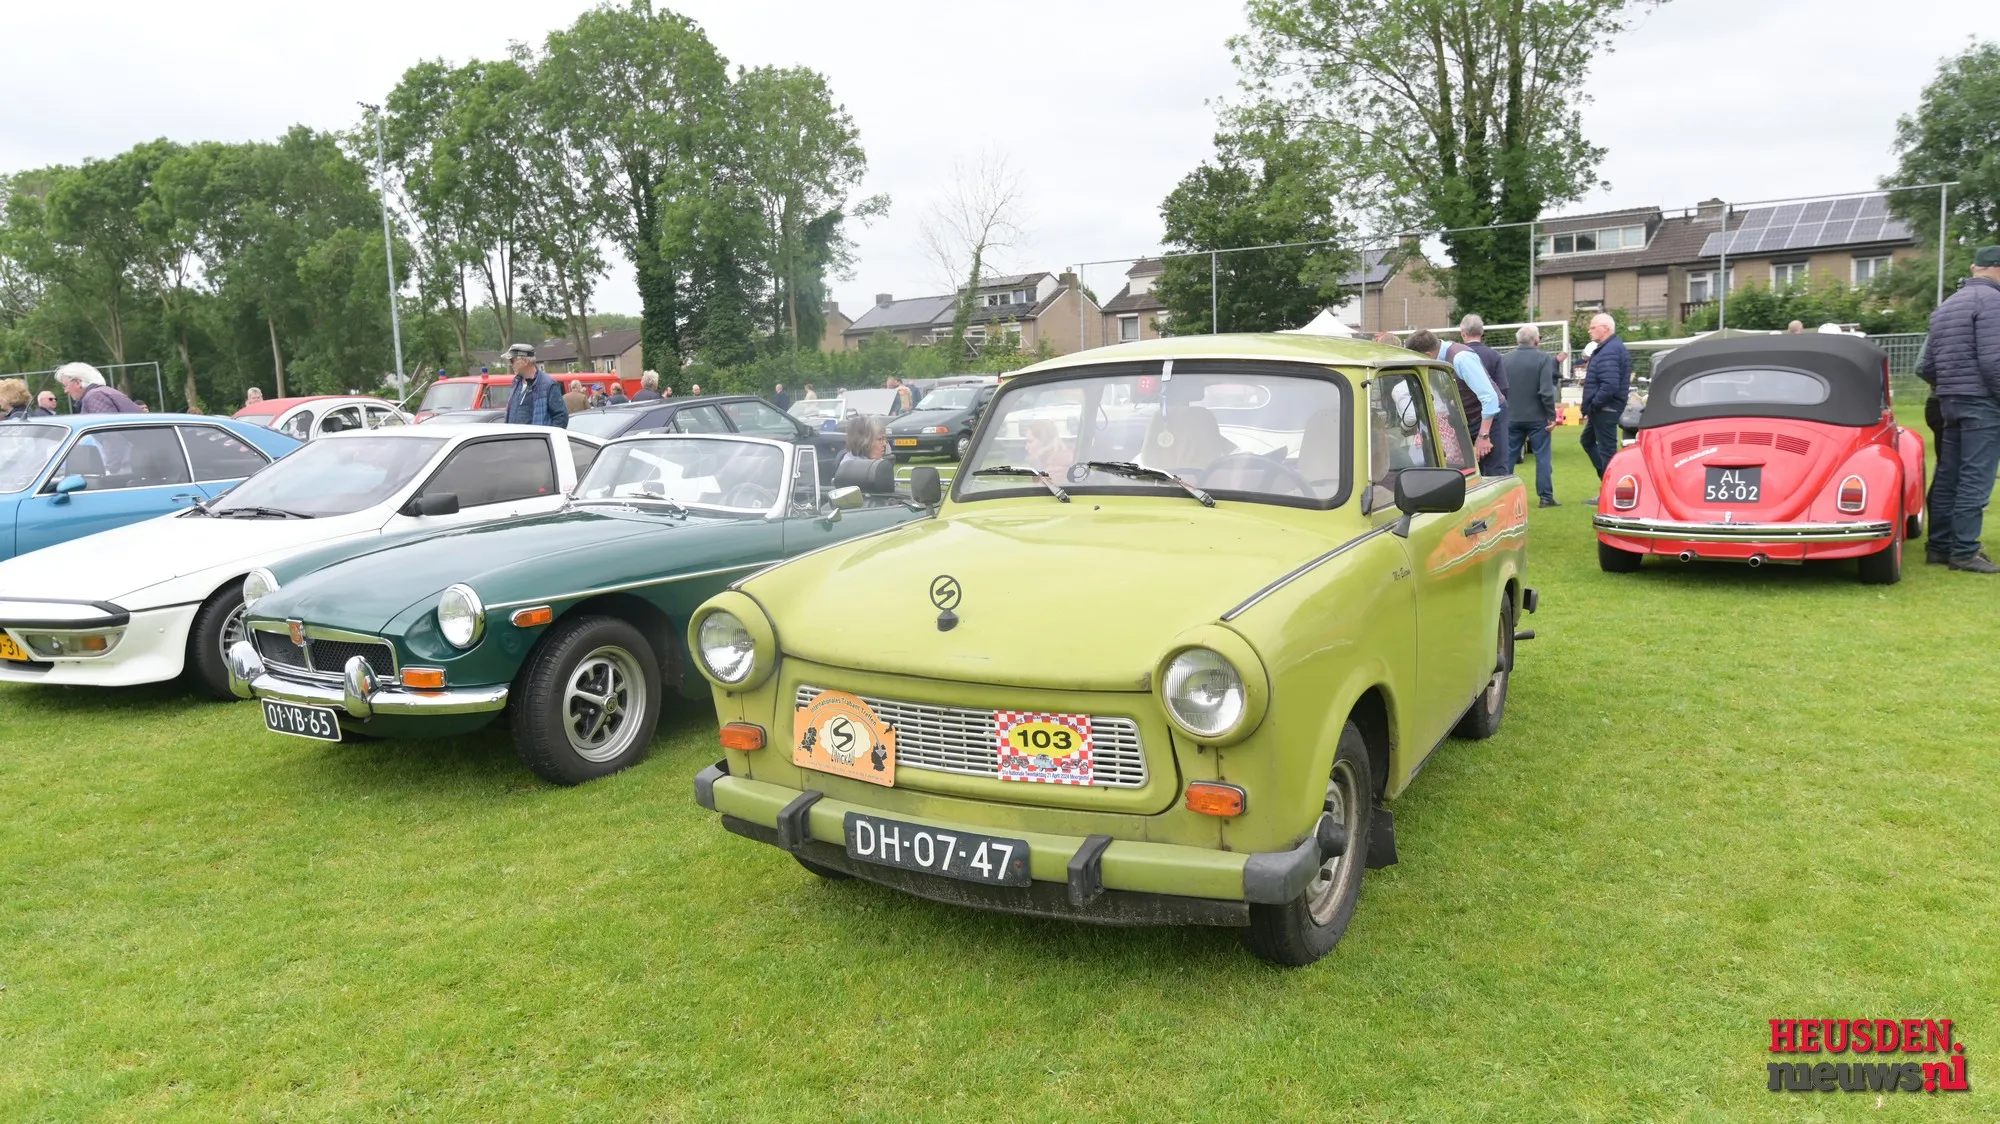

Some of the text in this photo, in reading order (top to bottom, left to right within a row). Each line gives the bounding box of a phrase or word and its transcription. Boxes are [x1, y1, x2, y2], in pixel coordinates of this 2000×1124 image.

[1720, 470, 1746, 484] AL
[1706, 485, 1758, 500] 56-02
[0, 638, 20, 657] -31
[268, 704, 331, 736] 01-YB-65
[1017, 730, 1072, 750] 103
[856, 820, 1014, 880] DH-07-47
